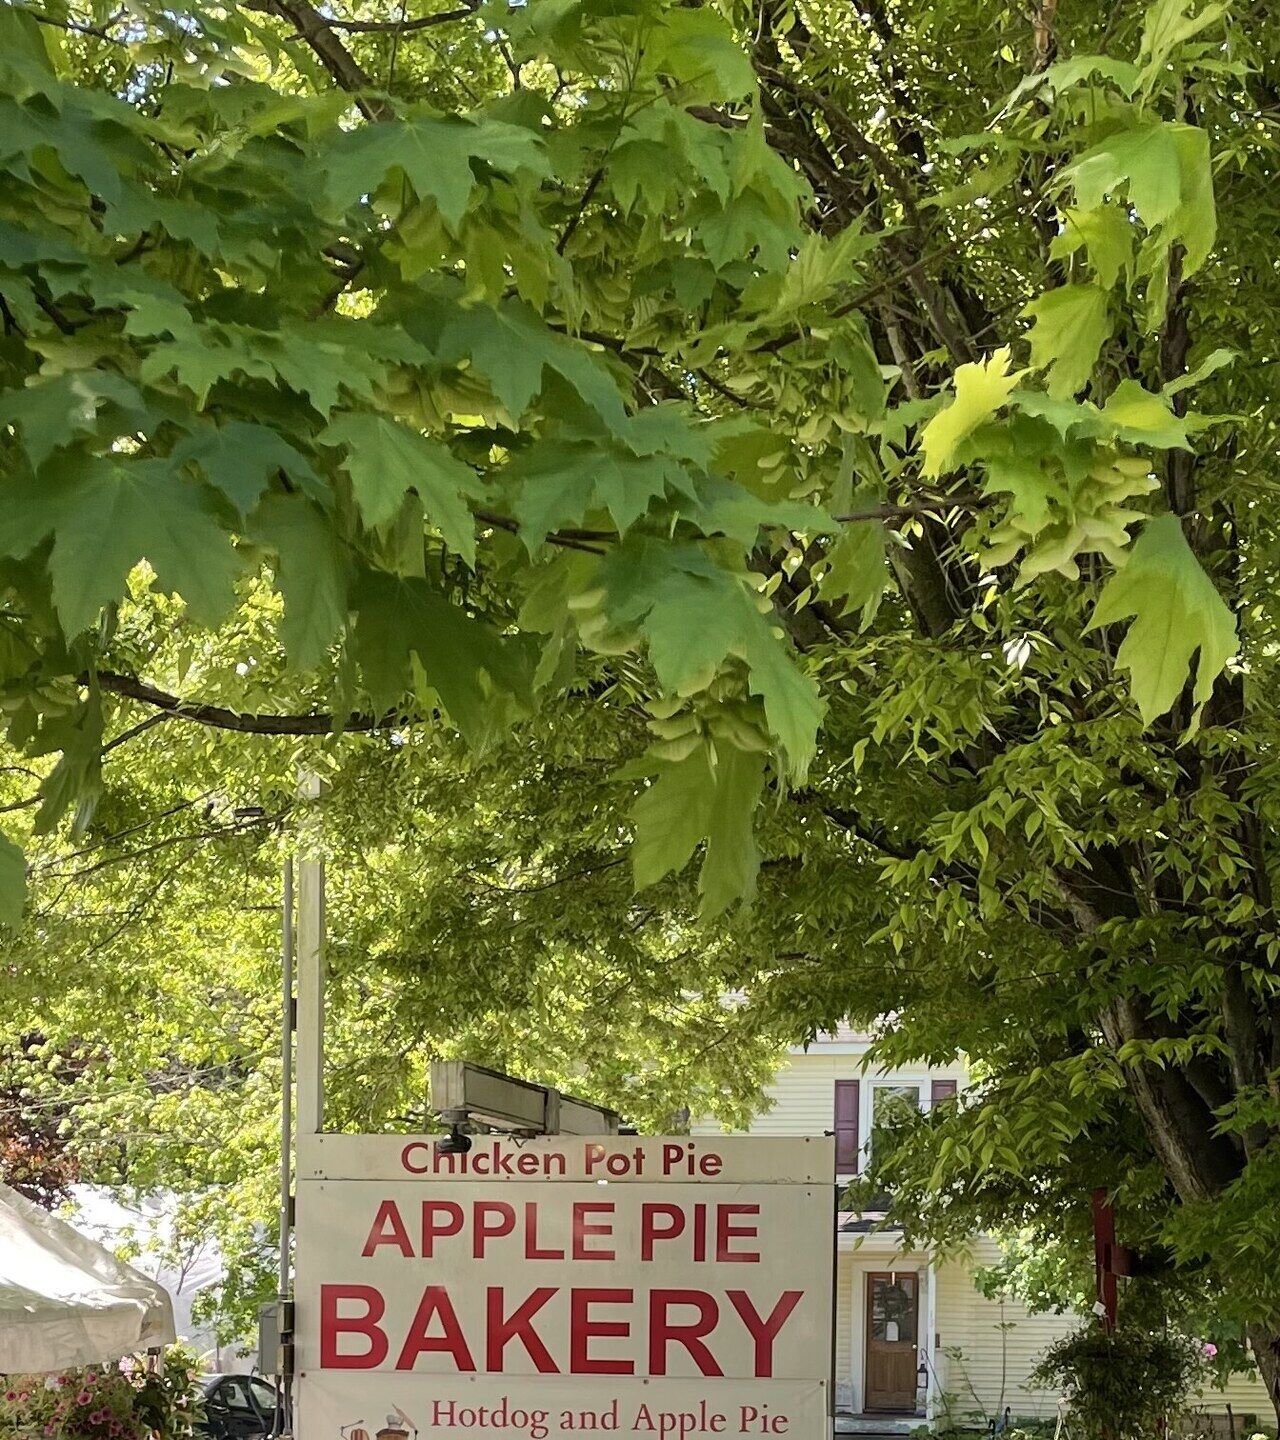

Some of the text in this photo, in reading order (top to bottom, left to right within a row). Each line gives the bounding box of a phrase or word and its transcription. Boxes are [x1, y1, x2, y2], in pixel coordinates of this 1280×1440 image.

[401, 1141, 723, 1176] Chicken Pot Pie
[361, 1200, 761, 1263] APPLE PIE
[320, 1283, 805, 1377] BAKERY
[430, 1396, 549, 1440] Hotdog
[560, 1399, 620, 1431] and
[738, 1405, 790, 1435] Pie
